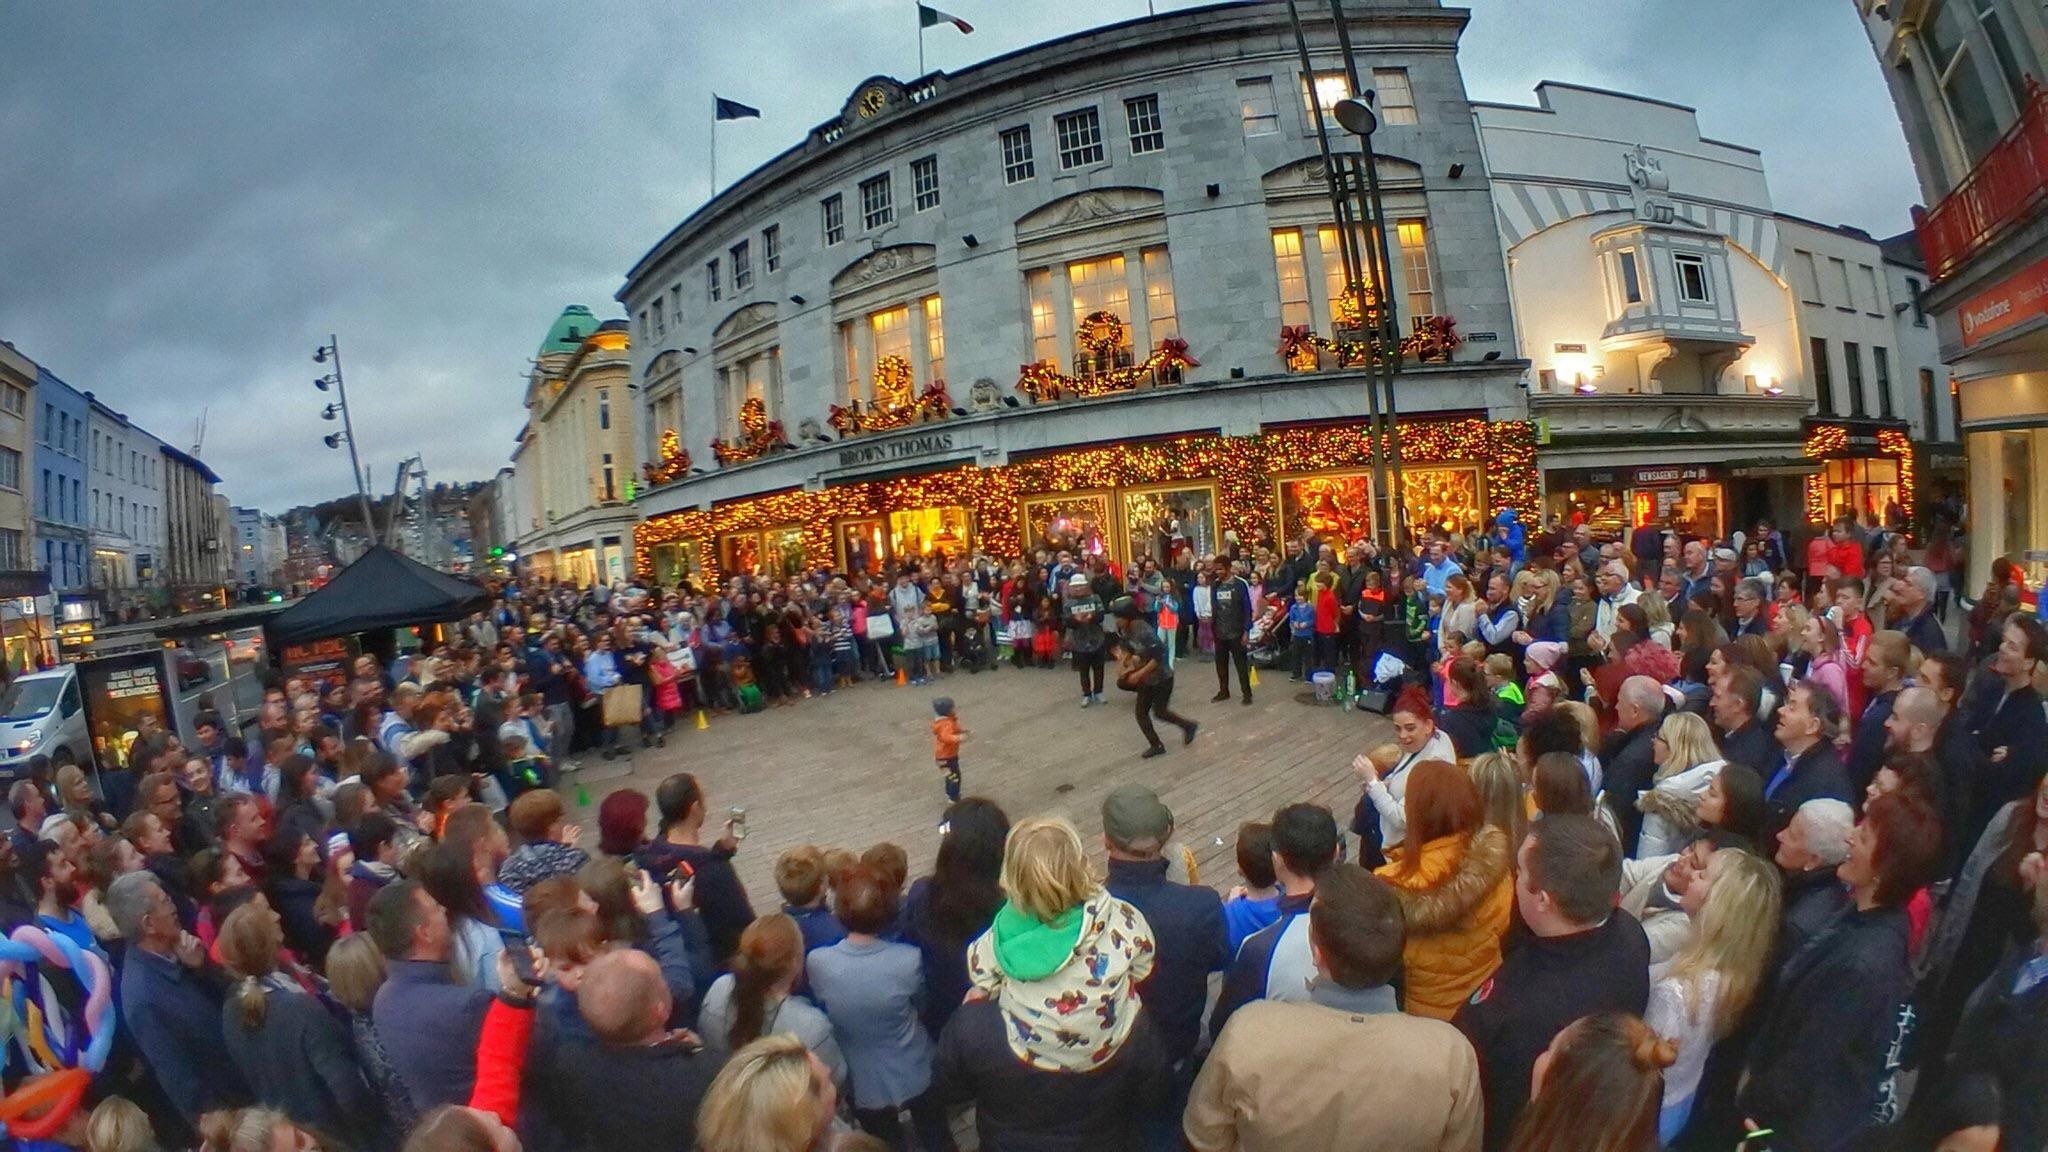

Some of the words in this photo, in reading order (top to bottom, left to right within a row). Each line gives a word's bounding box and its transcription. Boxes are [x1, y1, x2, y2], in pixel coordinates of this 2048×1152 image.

[840, 443, 885, 465] BROWN
[887, 433, 953, 457] THOMAS
[1638, 470, 1679, 481] NEWSAGENTS
